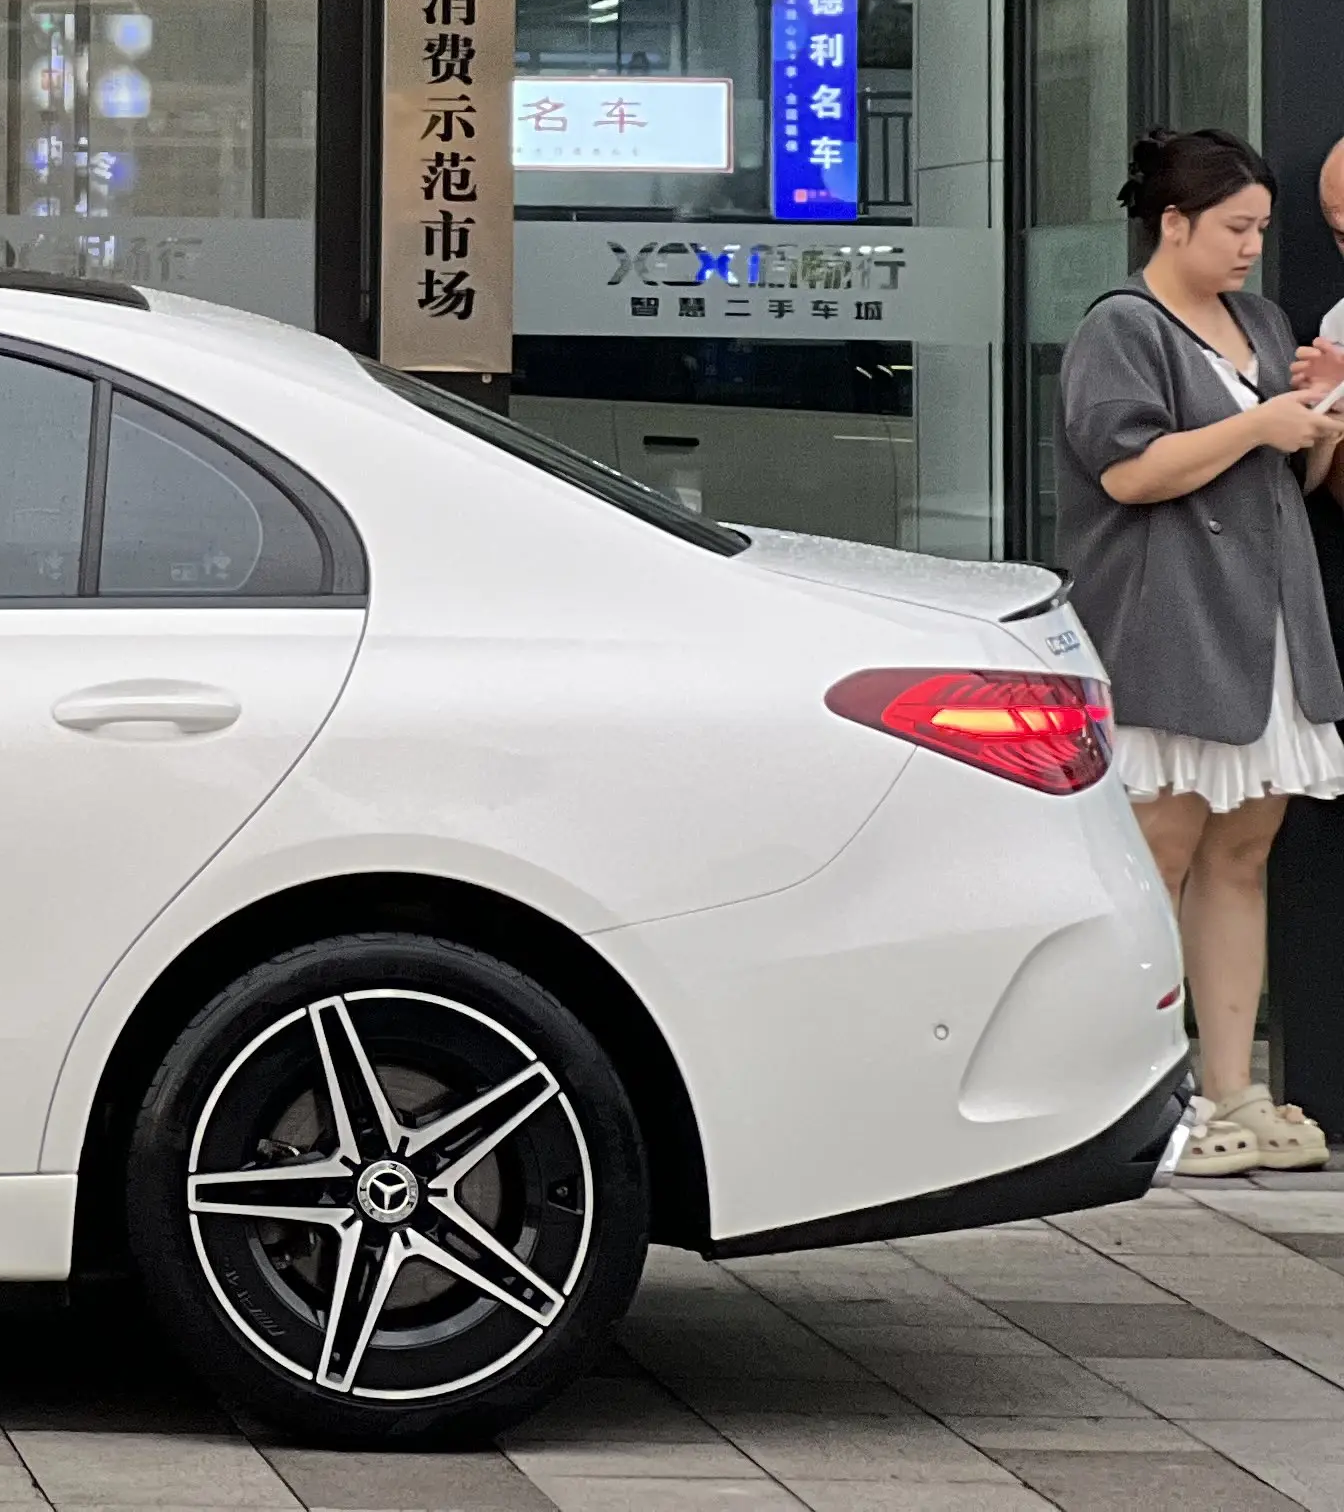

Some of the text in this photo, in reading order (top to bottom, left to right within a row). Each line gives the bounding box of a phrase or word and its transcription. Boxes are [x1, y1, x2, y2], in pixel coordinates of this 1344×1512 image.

[517, 96, 649, 134] 名车
[630, 295, 884, 322] 智慧二手车城
